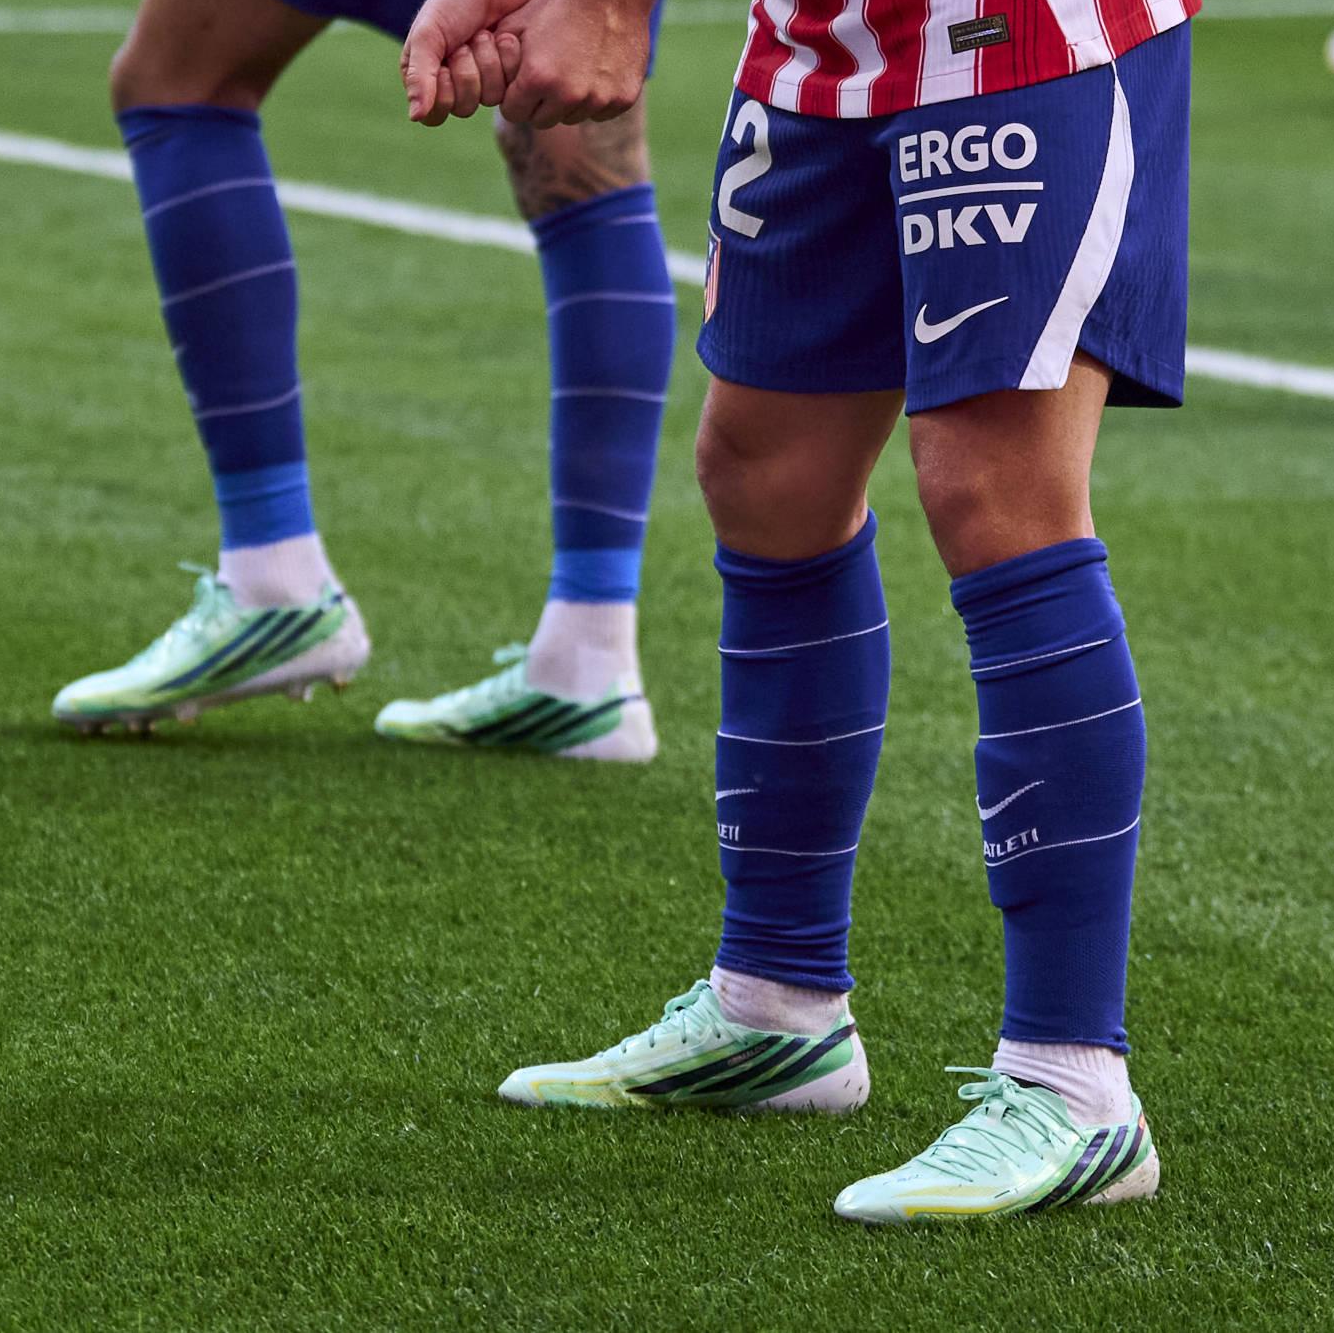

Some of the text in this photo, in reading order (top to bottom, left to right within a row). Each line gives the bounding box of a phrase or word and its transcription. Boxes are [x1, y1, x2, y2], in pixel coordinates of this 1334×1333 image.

[898, 122, 1038, 182] ERGO
[902, 203, 1036, 256] DKV
[717, 822, 740, 842] LETI
[982, 827, 1040, 858] ATLETI
